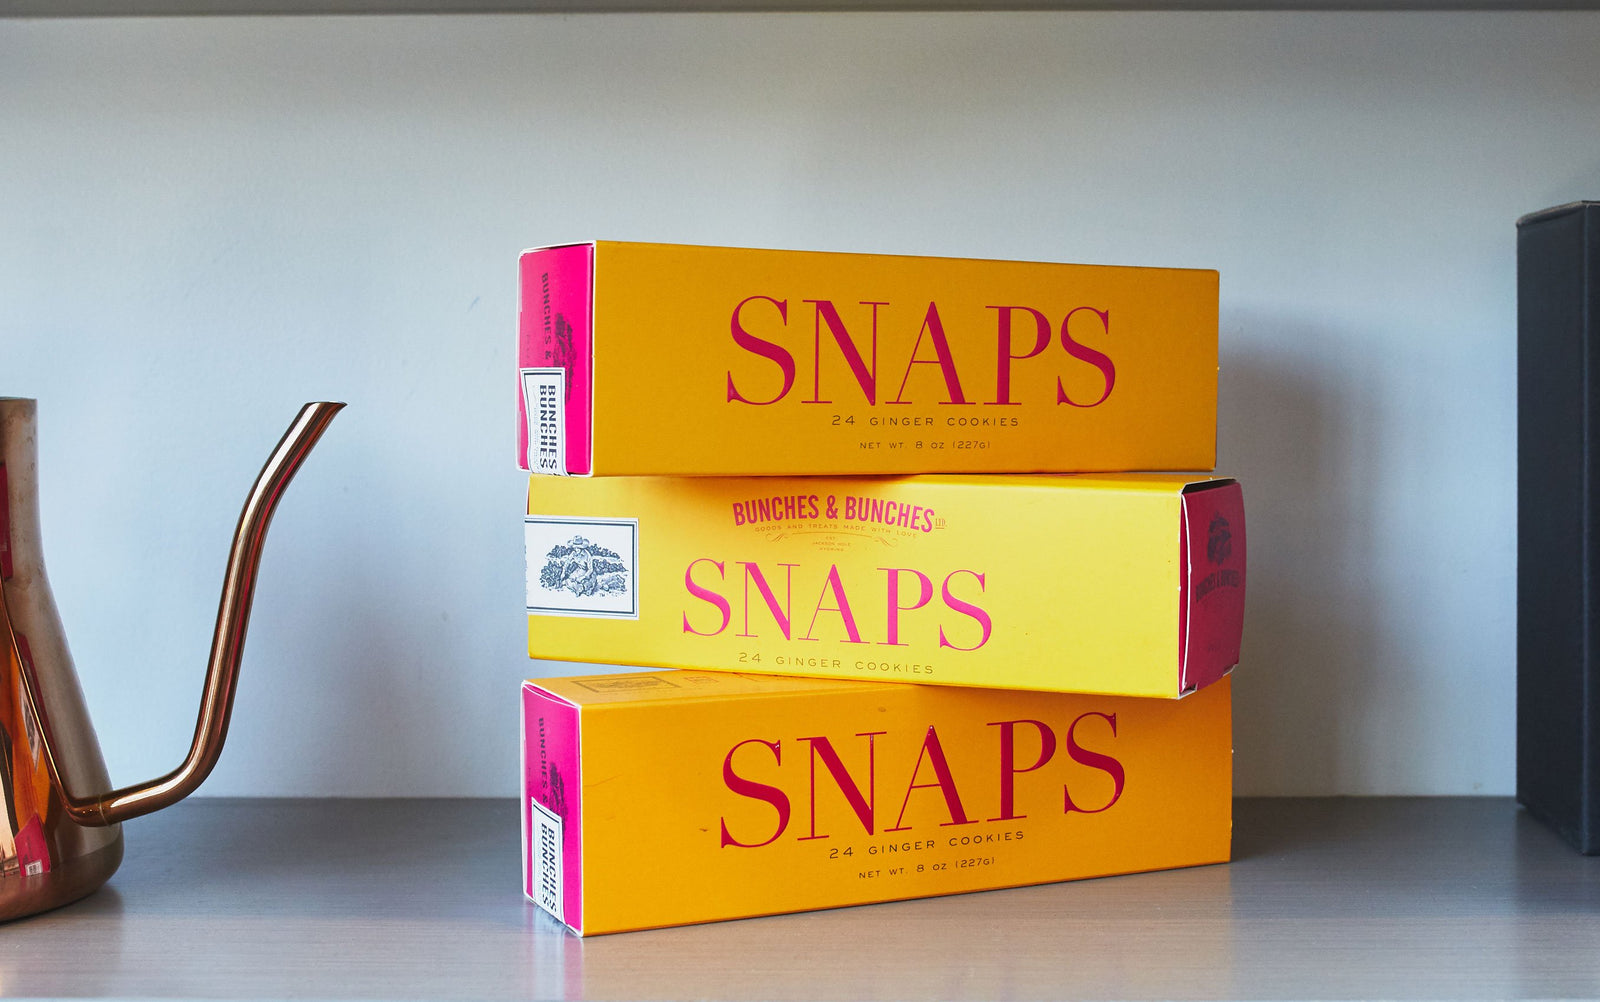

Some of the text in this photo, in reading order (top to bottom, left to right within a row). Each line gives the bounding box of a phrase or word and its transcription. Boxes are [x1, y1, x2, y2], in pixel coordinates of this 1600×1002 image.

[541, 272, 552, 345] BUNCHES
[727, 295, 1116, 408] SNAPS
[539, 384, 548, 469] BUNCHES
[548, 384, 557, 470] BUNCHES
[832, 414, 1020, 428] 24 GINGER COOKIES
[859, 440, 881, 450] NET
[915, 439, 924, 450] 8
[732, 494, 820, 527] BUNCHES
[825, 494, 839, 520] &
[844, 495, 935, 533] BUNCHES
[843, 524, 866, 532] MADE
[896, 529, 917, 538] LOVE
[682, 558, 993, 651] SNAPS
[738, 652, 934, 674] 24 GINGER COOKIES
[720, 711, 1126, 849] SNAPS
[541, 822, 549, 907] BUNCHES
[548, 825, 557, 913] BUNCHES
[829, 830, 1026, 860] 24 GINGER COOKIES
[858, 870, 881, 879] NET
[916, 864, 925, 873] 8
